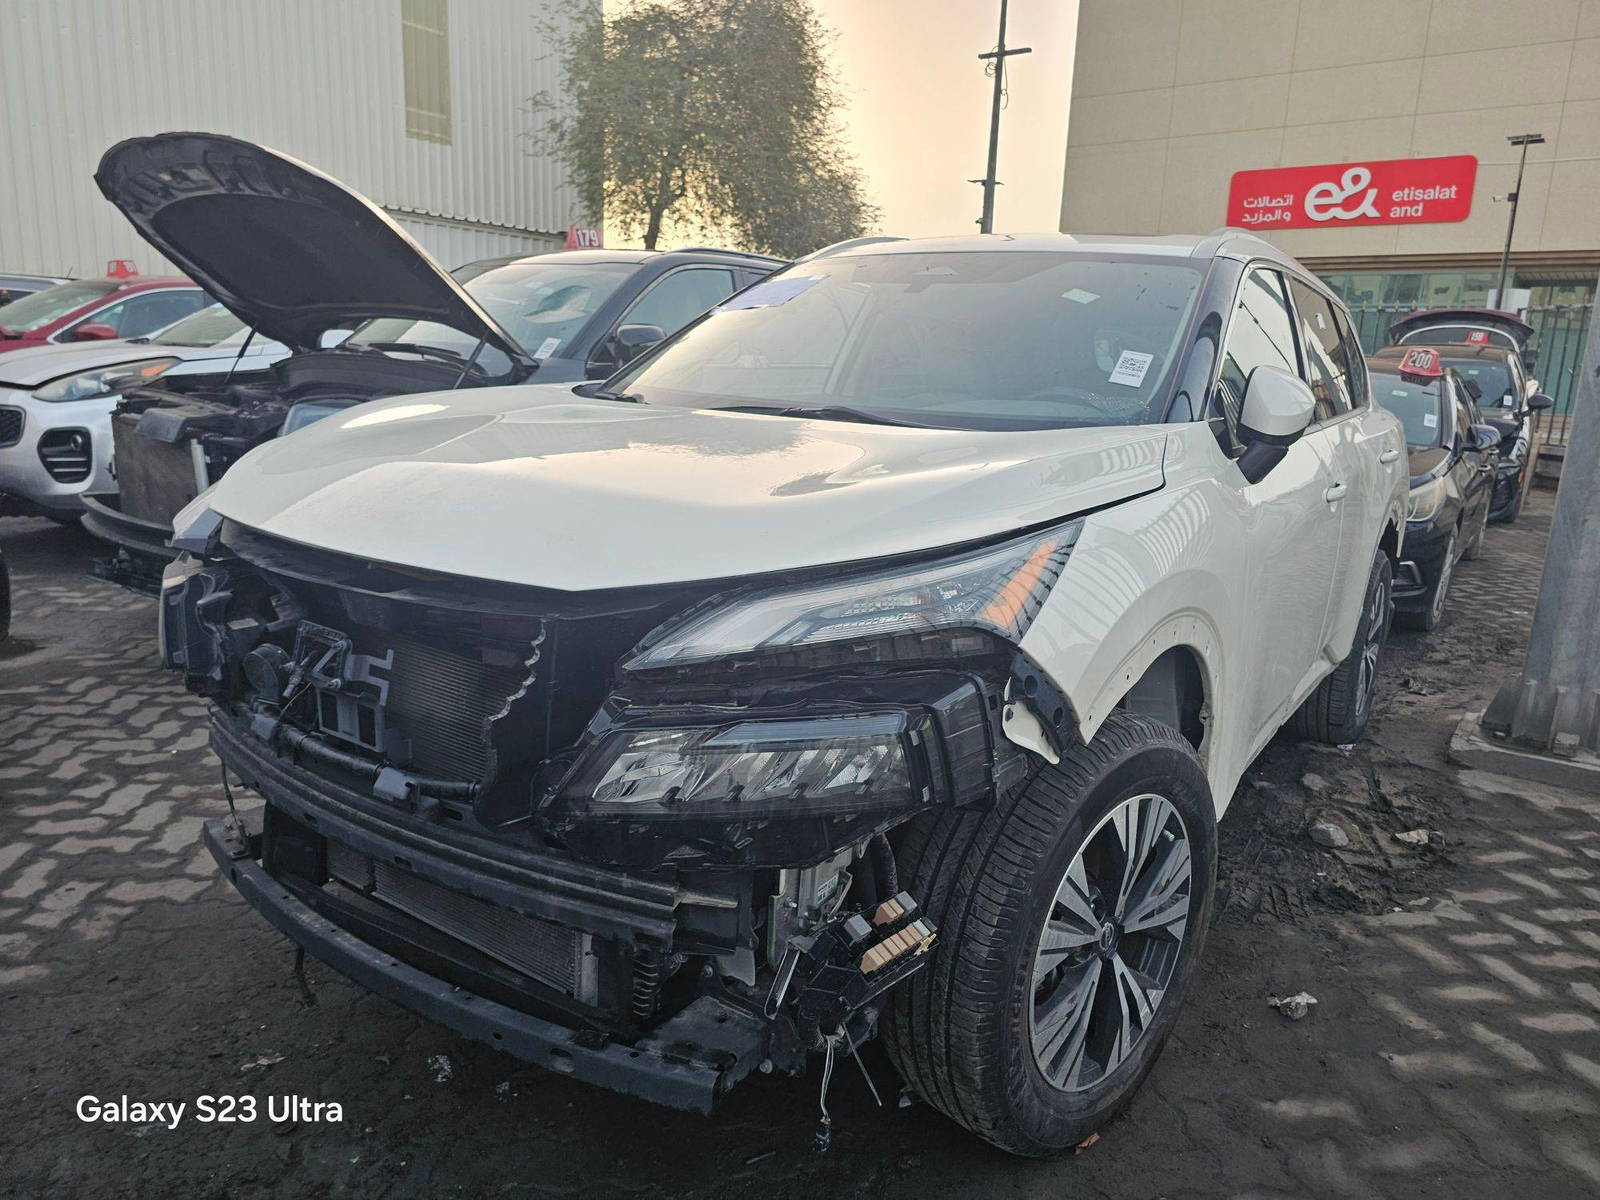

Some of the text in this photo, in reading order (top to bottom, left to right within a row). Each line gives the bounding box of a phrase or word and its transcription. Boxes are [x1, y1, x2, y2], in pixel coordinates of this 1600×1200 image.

[1243, 194, 1294, 208] اتصالات
[1304, 167, 1381, 221] e&
[1392, 185, 1457, 201] etisalat
[1242, 209, 1291, 224] والمزيد
[1390, 204, 1423, 218] and
[577, 230, 600, 247] 179
[1408, 352, 1433, 369] 200
